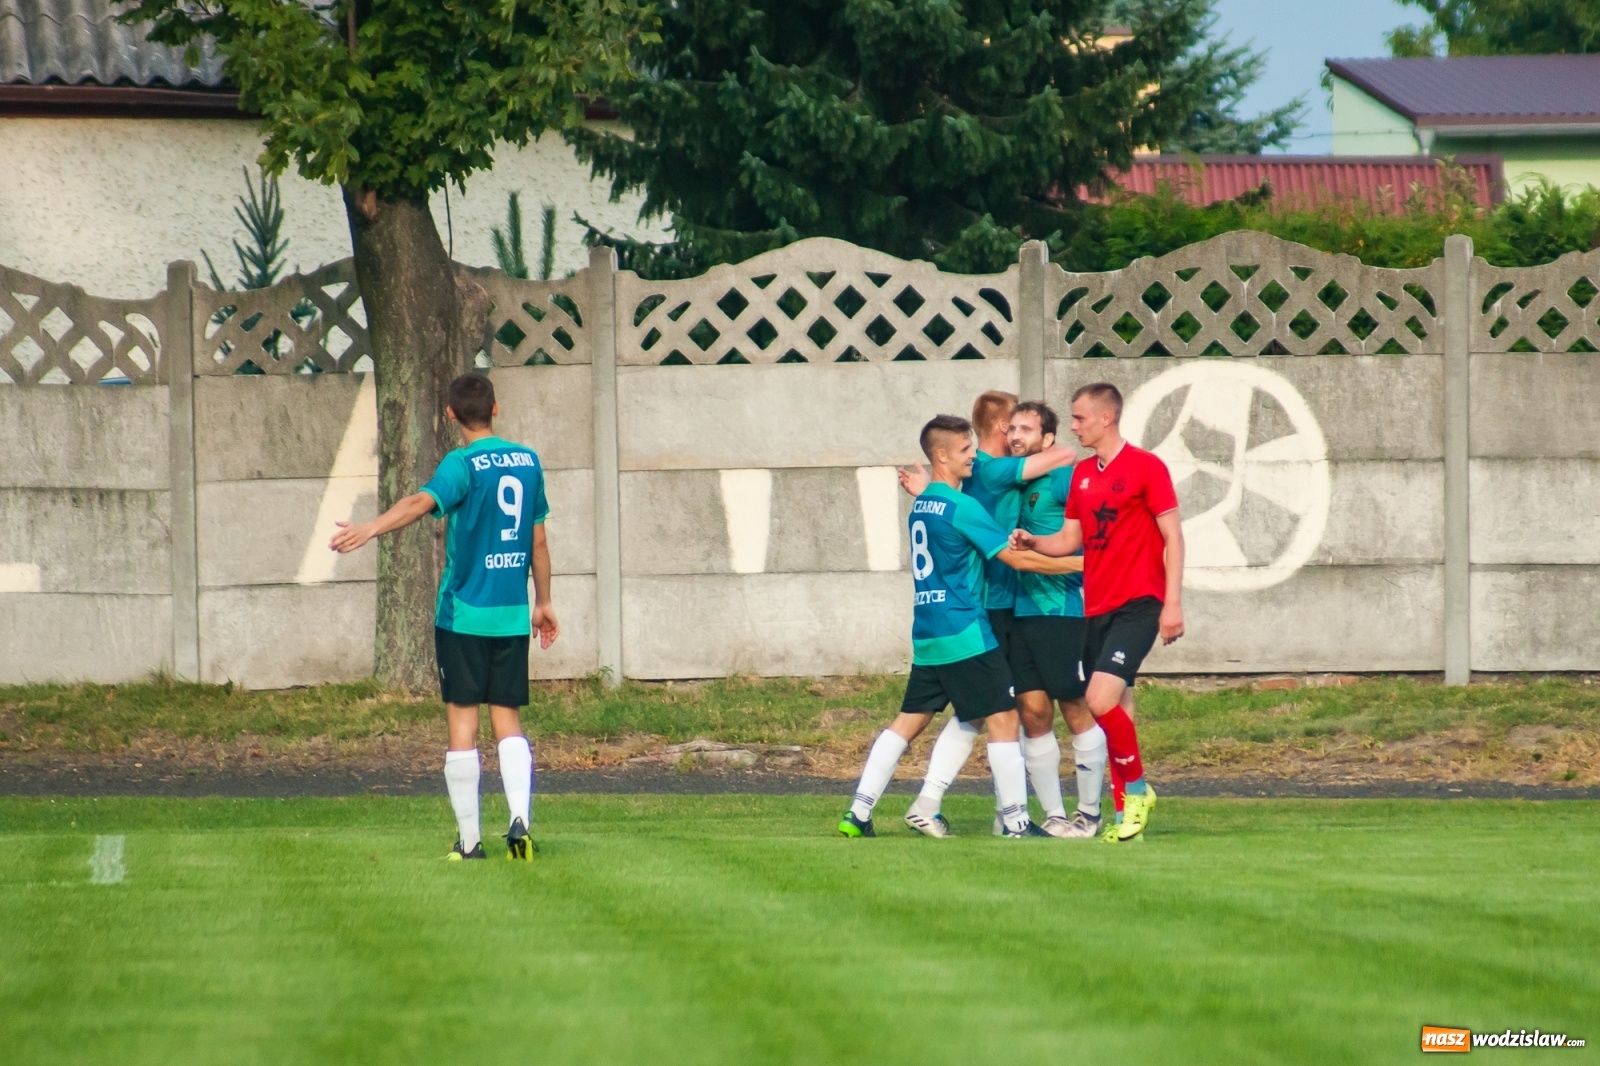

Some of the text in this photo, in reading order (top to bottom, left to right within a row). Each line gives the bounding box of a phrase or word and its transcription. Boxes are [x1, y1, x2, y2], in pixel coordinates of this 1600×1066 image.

[471, 454, 491, 471] KS
[497, 475, 524, 541] 9
[913, 500, 947, 516] CZARNI
[912, 520, 935, 581] 8
